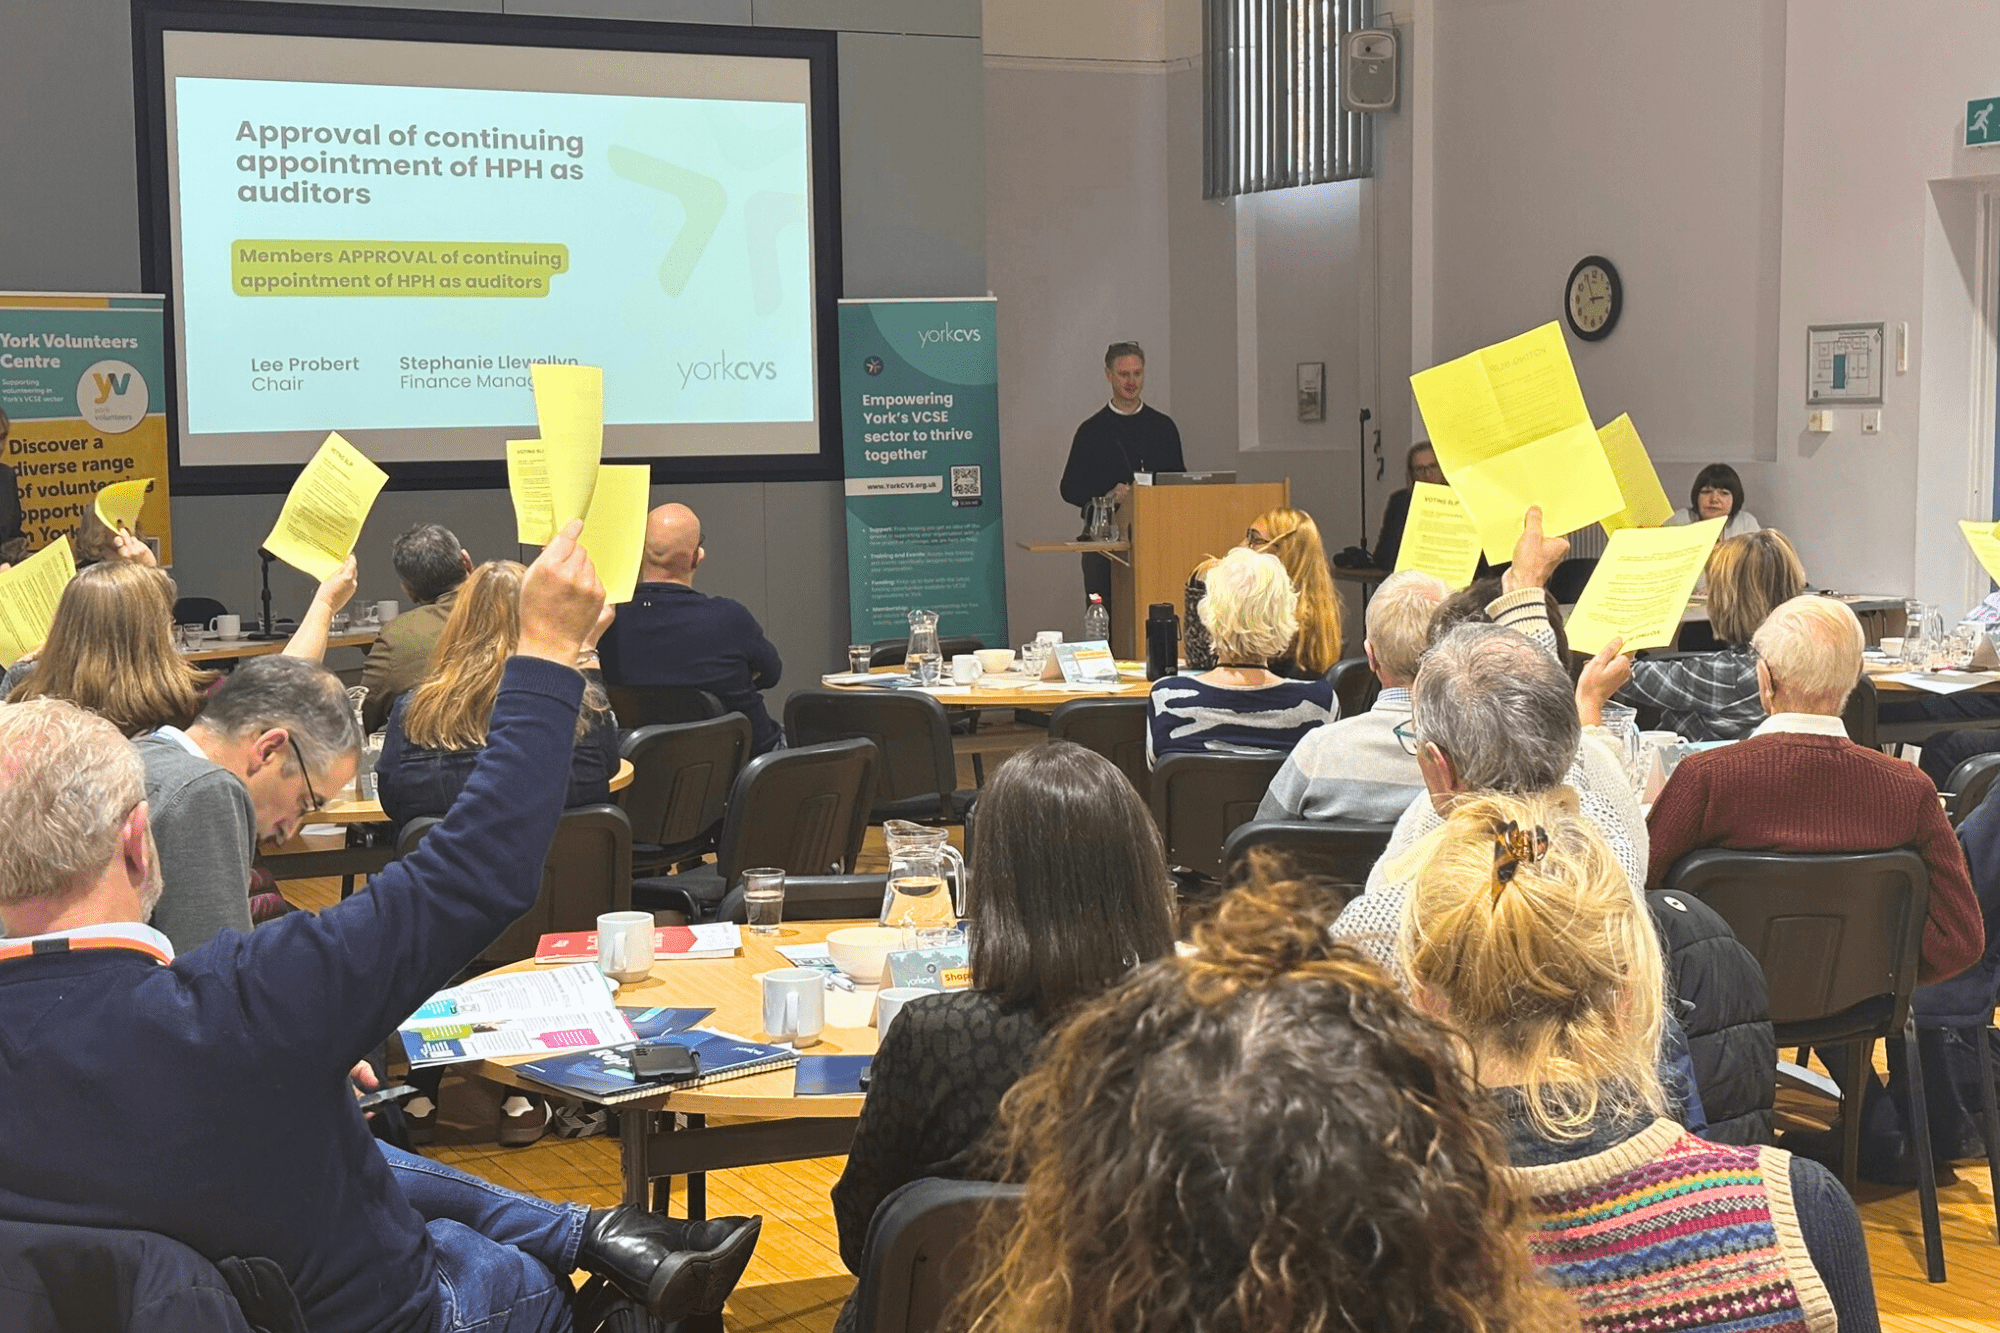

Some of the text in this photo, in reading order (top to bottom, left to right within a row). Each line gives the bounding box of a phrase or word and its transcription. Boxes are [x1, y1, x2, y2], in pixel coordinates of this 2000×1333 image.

[236, 119, 584, 158] Approval of continuing
[236, 151, 584, 181] appointment of HPH as
[238, 179, 371, 205] auditors
[239, 247, 562, 270] Members APPROVAL of continuing
[240, 272, 542, 292] appointment of HPH as auditors
[0, 333, 138, 349] York Volunteers
[918, 321, 981, 349] yorkcvs
[0, 354, 61, 368] Centre
[251, 356, 360, 373] Lee Probert
[399, 354, 579, 372] Stephanie Llewellyn
[677, 349, 777, 390] yorkcvs
[252, 375, 304, 392] Chair
[400, 374, 537, 392] Finance Manag
[863, 392, 954, 409] Empowering
[863, 411, 949, 424] York's VCSE
[864, 428, 973, 442] sector to thrive
[9, 438, 104, 455] Discover a
[865, 448, 928, 464] together
[14, 457, 134, 477] diverse range
[945, 973, 971, 982] Shap
